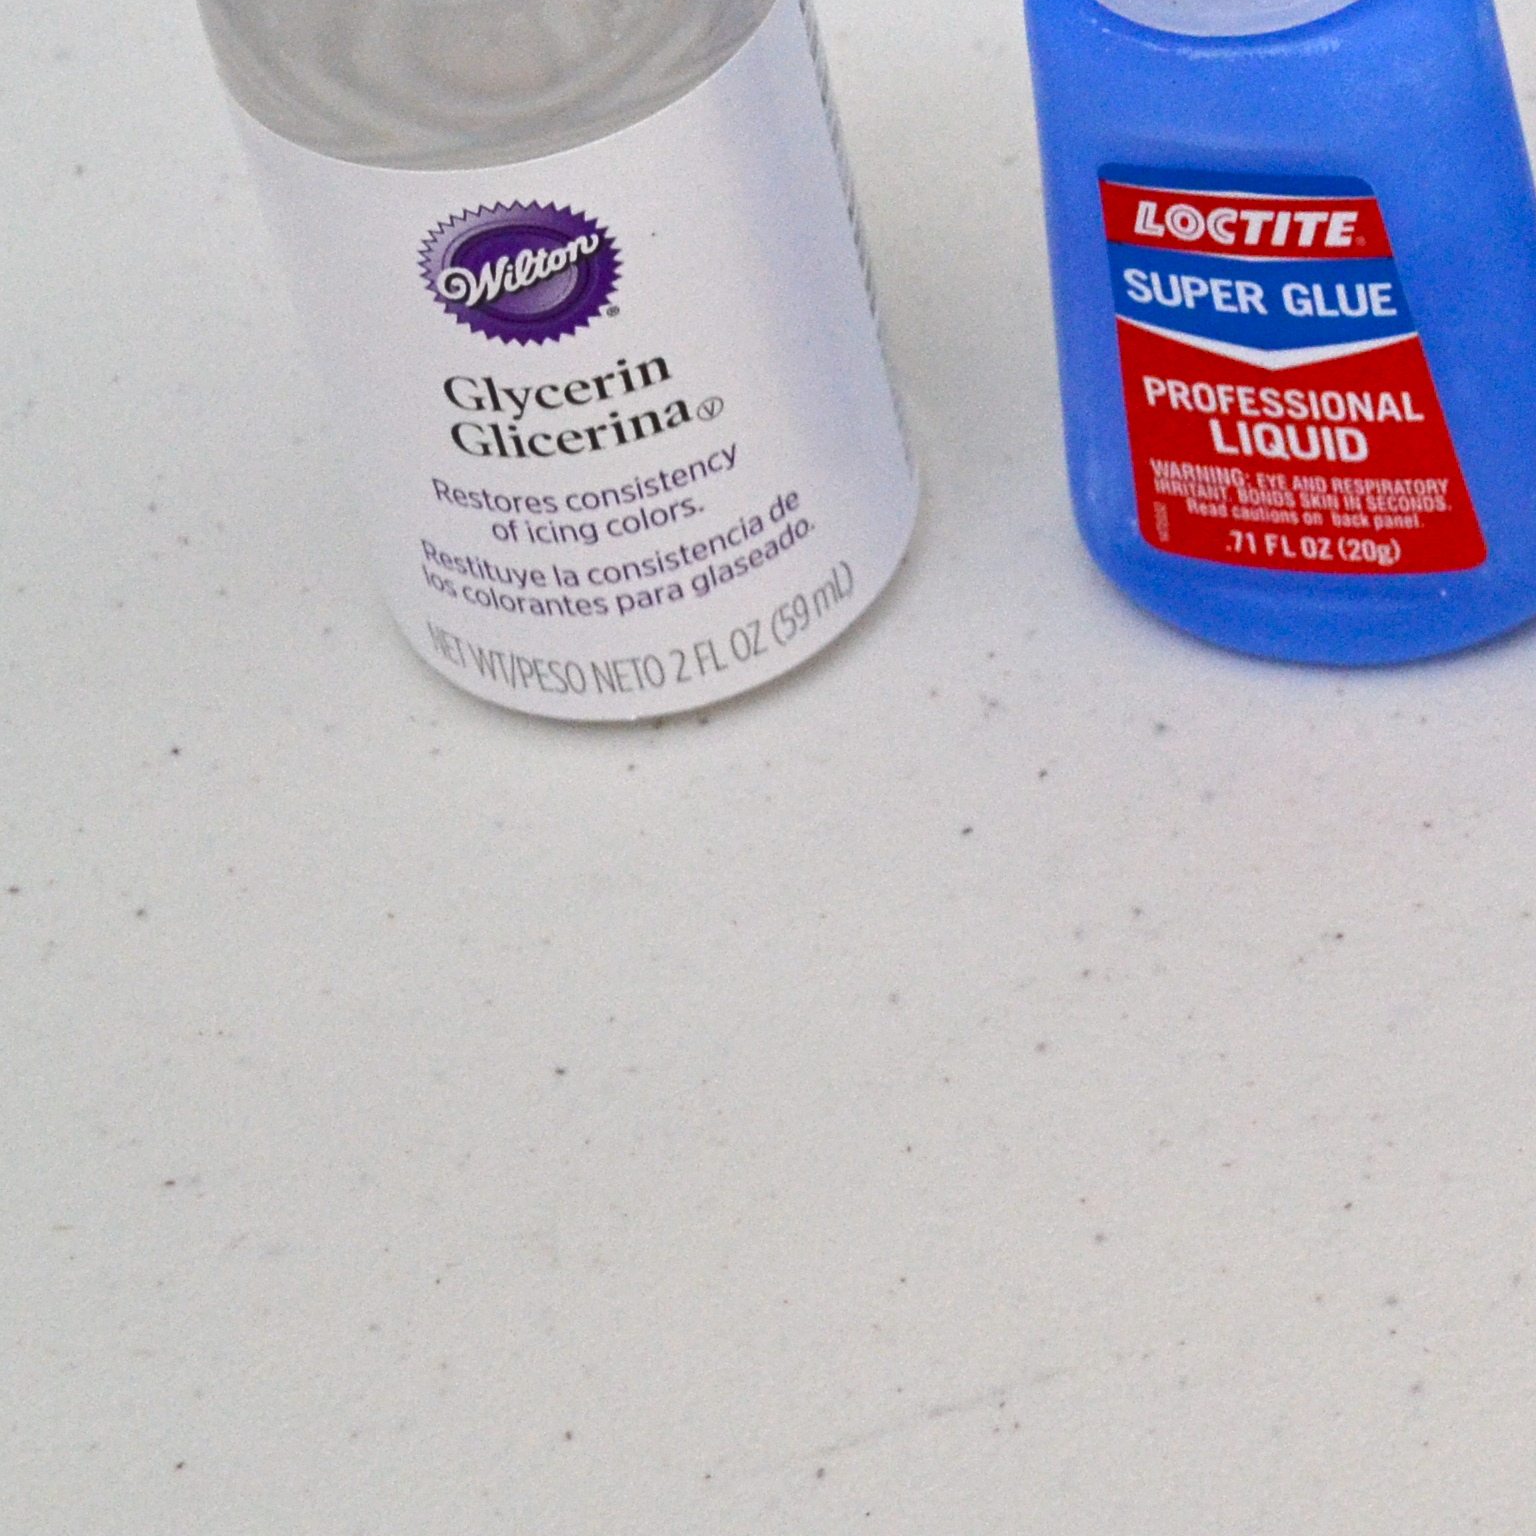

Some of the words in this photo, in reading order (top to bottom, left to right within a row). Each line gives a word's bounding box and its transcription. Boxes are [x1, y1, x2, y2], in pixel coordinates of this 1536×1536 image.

[1134, 200, 1358, 247] LOCTITE
[437, 233, 600, 307] Wilton
[1123, 268, 1267, 315] SUPER
[1282, 282, 1397, 317] GLUE
[443, 354, 672, 421] Glycerin
[1143, 375, 1424, 422] PROFESSIONAL
[450, 397, 692, 458] Glicerina
[1209, 418, 1368, 463] LIQUID
[431, 477, 558, 515] Restores
[565, 443, 739, 513] consistency
[1150, 458, 1250, 487] WARNING:
[1256, 472, 1287, 490] EYE
[1292, 475, 1327, 493] AND
[1331, 477, 1449, 496] RESPIRATORY
[1237, 485, 1296, 509] BONDS
[1299, 491, 1340, 510] SKIN
[1343, 494, 1362, 511] IN
[1365, 493, 1452, 513] SECONDS.
[491, 518, 521, 543] of
[527, 516, 600, 545] icing
[607, 502, 705, 538] colors.
[1187, 497, 1229, 518] Read
[1231, 504, 1299, 525] cautions
[1302, 511, 1323, 526] on
[1331, 513, 1370, 529] back
[1373, 512, 1425, 532] panel.
[421, 538, 547, 590] Restituye
[553, 562, 580, 588] la
[587, 517, 764, 586] consistencia
[769, 489, 800, 522] de
[1225, 529, 1258, 554] .71
[1263, 533, 1297, 558] FL
[1300, 536, 1334, 561] OZ
[1337, 536, 1402, 568] (20g)
[423, 565, 457, 599] los
[462, 575, 609, 617] colorantes
[616, 585, 684, 617] para
[692, 514, 816, 596] glaseado.
[428, 621, 468, 671] NET
[467, 644, 586, 695] WT/PESO
[593, 652, 665, 695] NETO
[674, 650, 692, 683] 2
[696, 641, 729, 677] FL
[731, 620, 769, 658] OZ
